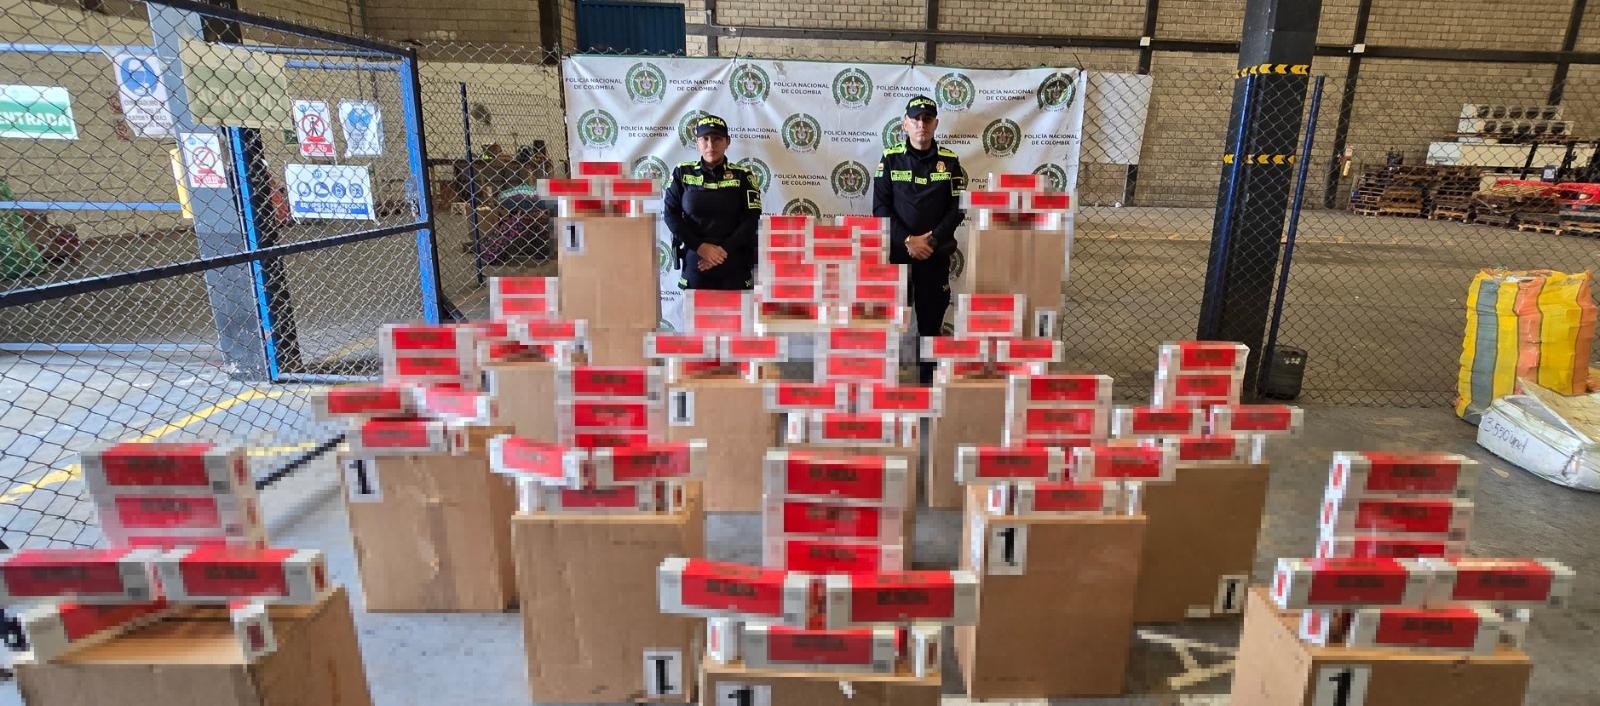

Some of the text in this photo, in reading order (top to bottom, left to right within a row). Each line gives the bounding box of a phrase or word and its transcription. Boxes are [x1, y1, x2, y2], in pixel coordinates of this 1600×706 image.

[566, 225, 580, 251] 1
[672, 392, 691, 422] 1
[349, 459, 375, 495] 1
[996, 527, 1018, 567] 1
